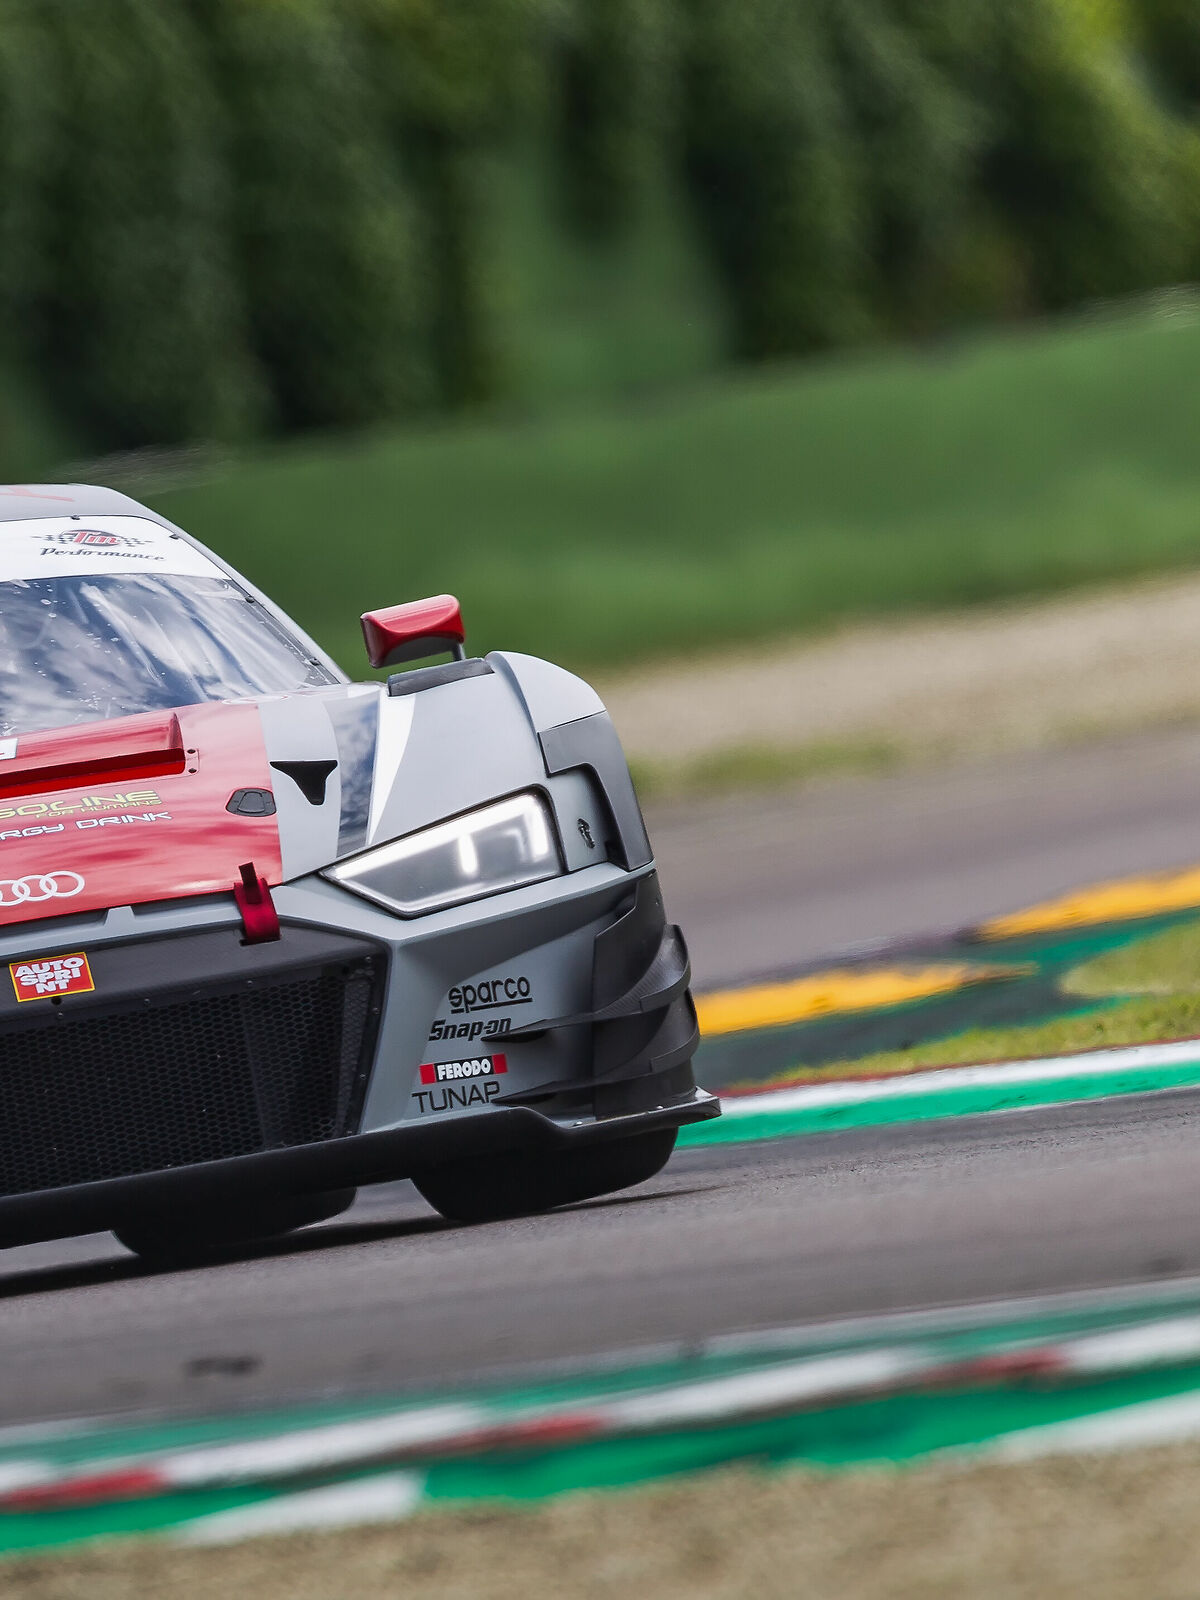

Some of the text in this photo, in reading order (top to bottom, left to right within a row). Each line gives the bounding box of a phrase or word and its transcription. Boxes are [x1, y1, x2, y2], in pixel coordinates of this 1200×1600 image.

[40, 548, 166, 561] Performance
[35, 799, 163, 819] FOR HUMANS
[77, 811, 173, 830] DRINK
[15, 957, 85, 978] AUTO
[20, 967, 81, 986] SPRI
[35, 979, 70, 994] NT
[448, 976, 531, 1013] sparco
[428, 1017, 512, 1041] Snap-on
[437, 1058, 491, 1081] FERODO
[411, 1081, 500, 1113] TUNAP
